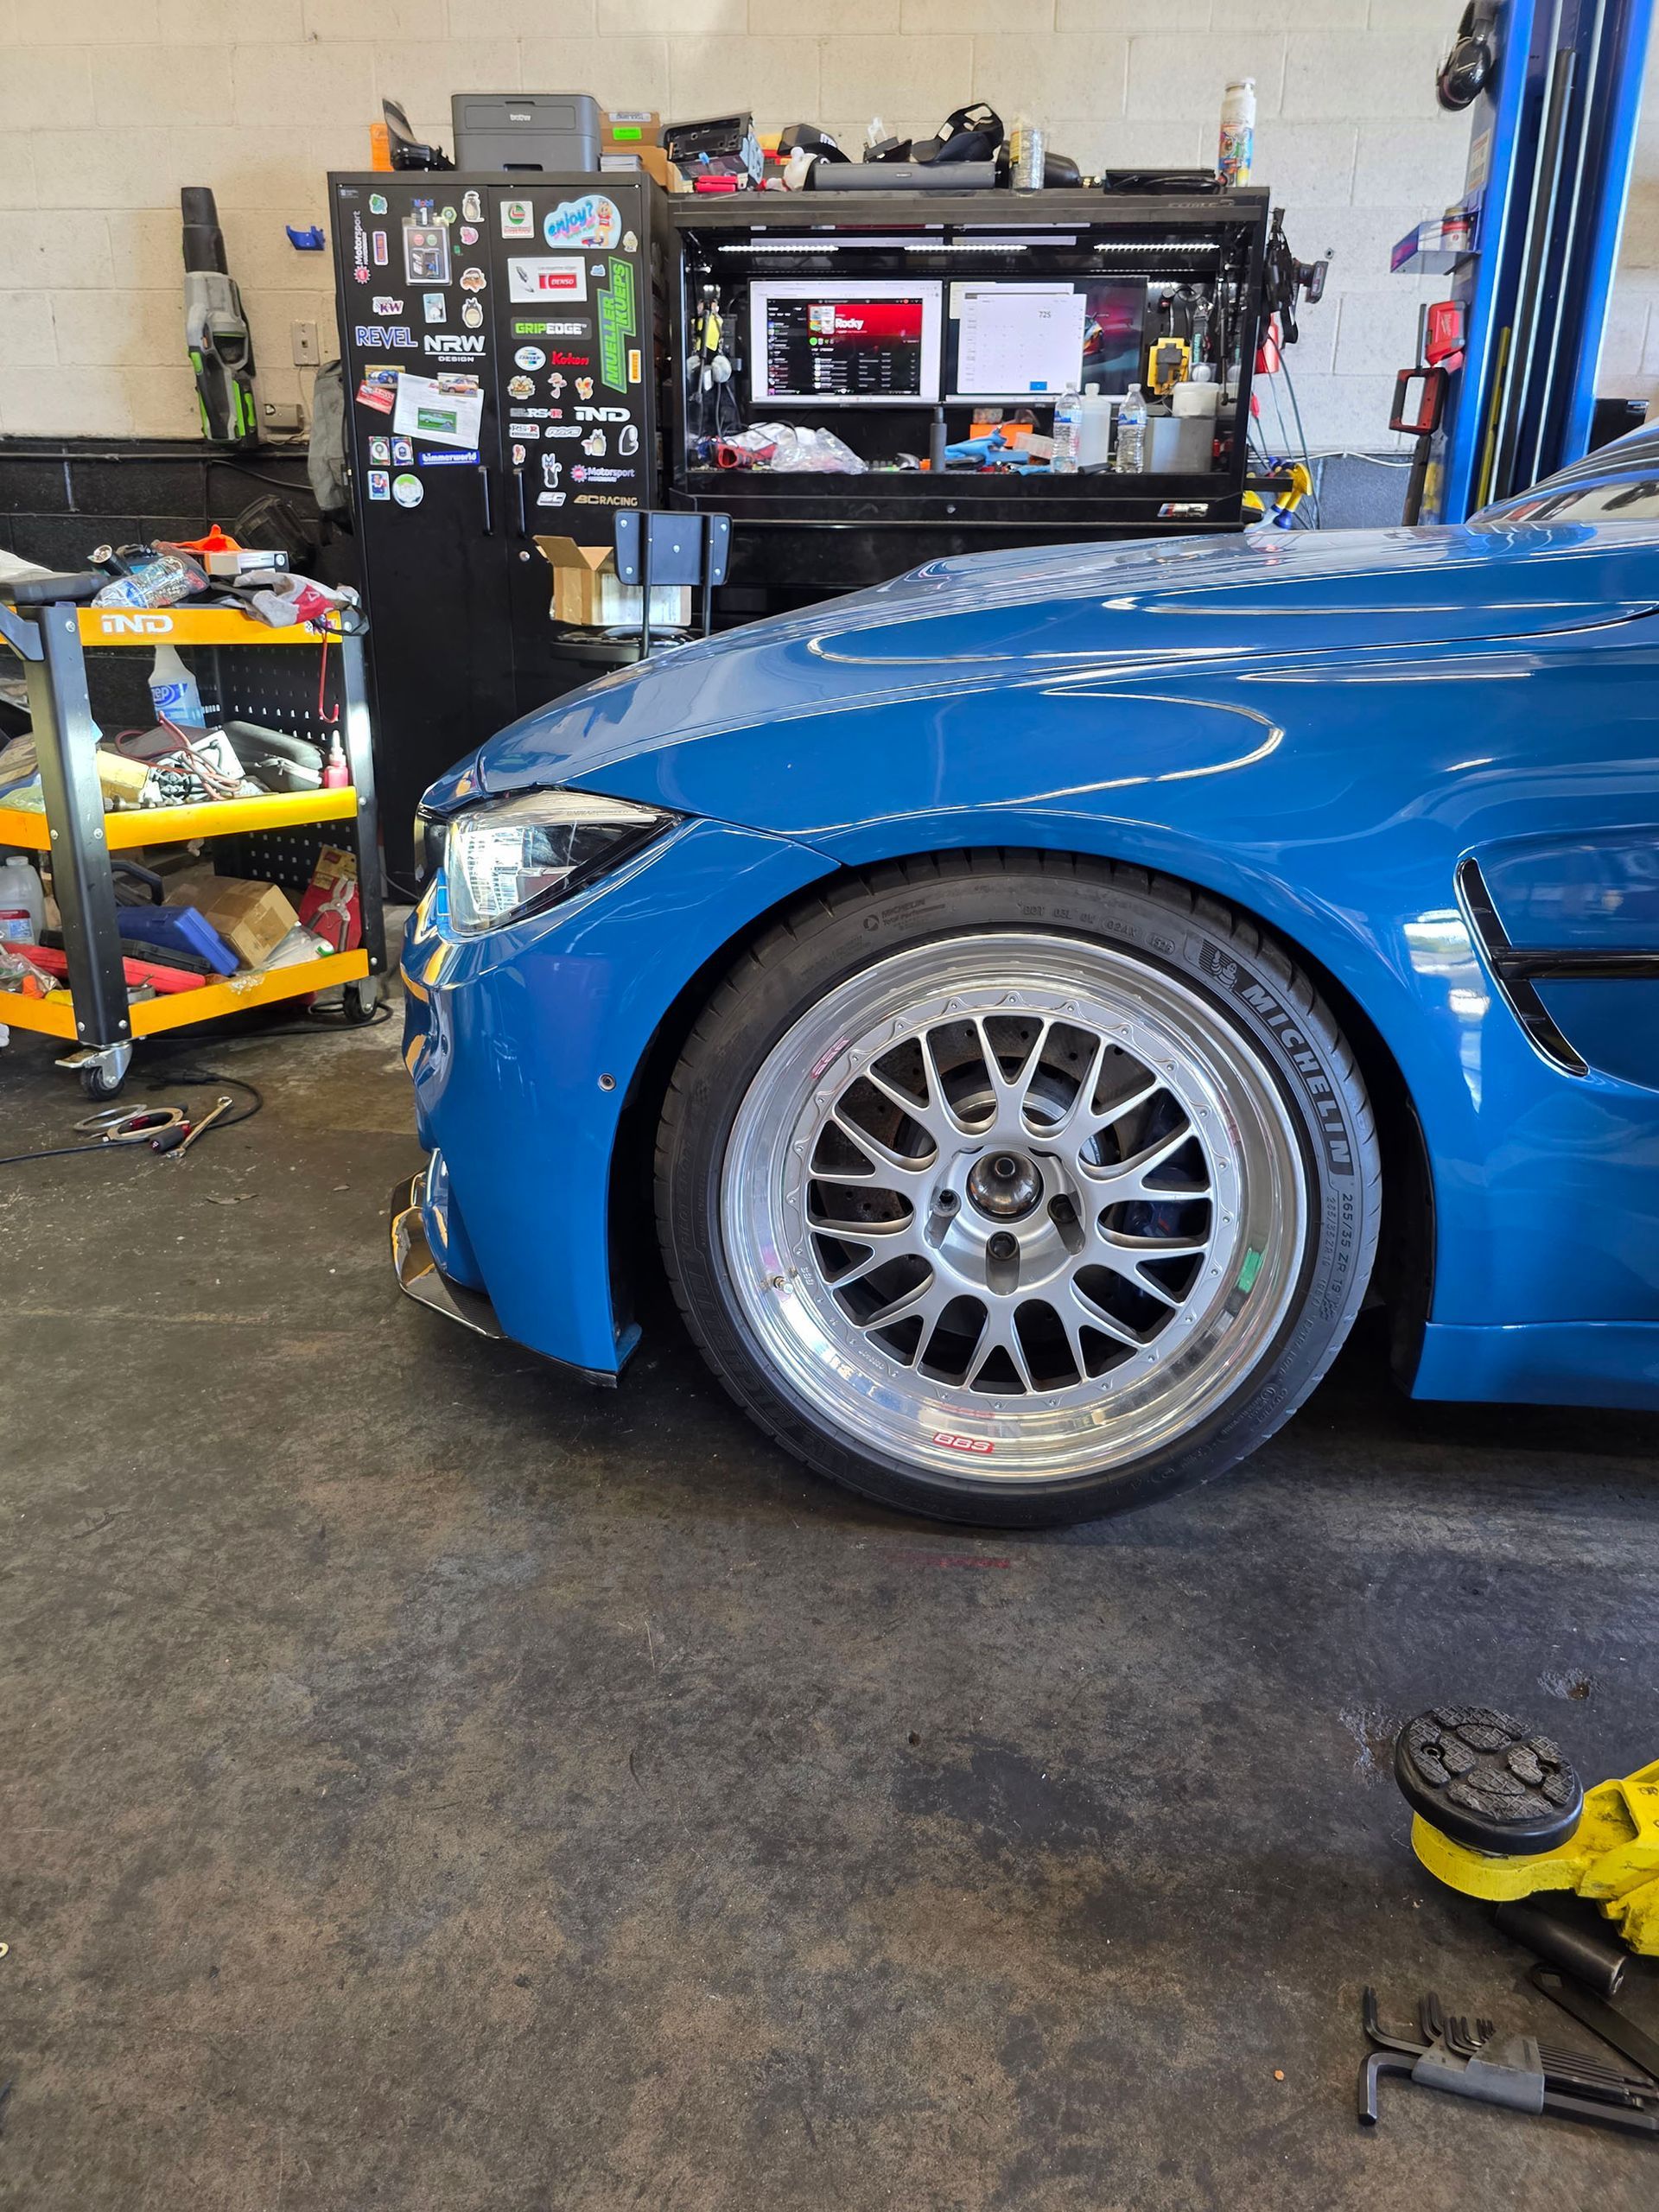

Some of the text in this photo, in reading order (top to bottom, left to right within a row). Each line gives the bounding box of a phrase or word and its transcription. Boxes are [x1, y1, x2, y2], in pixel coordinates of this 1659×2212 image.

[353, 210, 362, 264] Motorsport
[380, 302, 402, 313] KW
[835, 318, 865, 330] Rocky
[356, 326, 418, 349] REVEL
[423, 334, 486, 352] NRW
[422, 453, 477, 461] bimmerworld
[1242, 983, 1350, 1160] MICHELIN
[1332, 1193, 1354, 1294] 265/35 ZR 19
[933, 1433, 991, 1452] BBS
